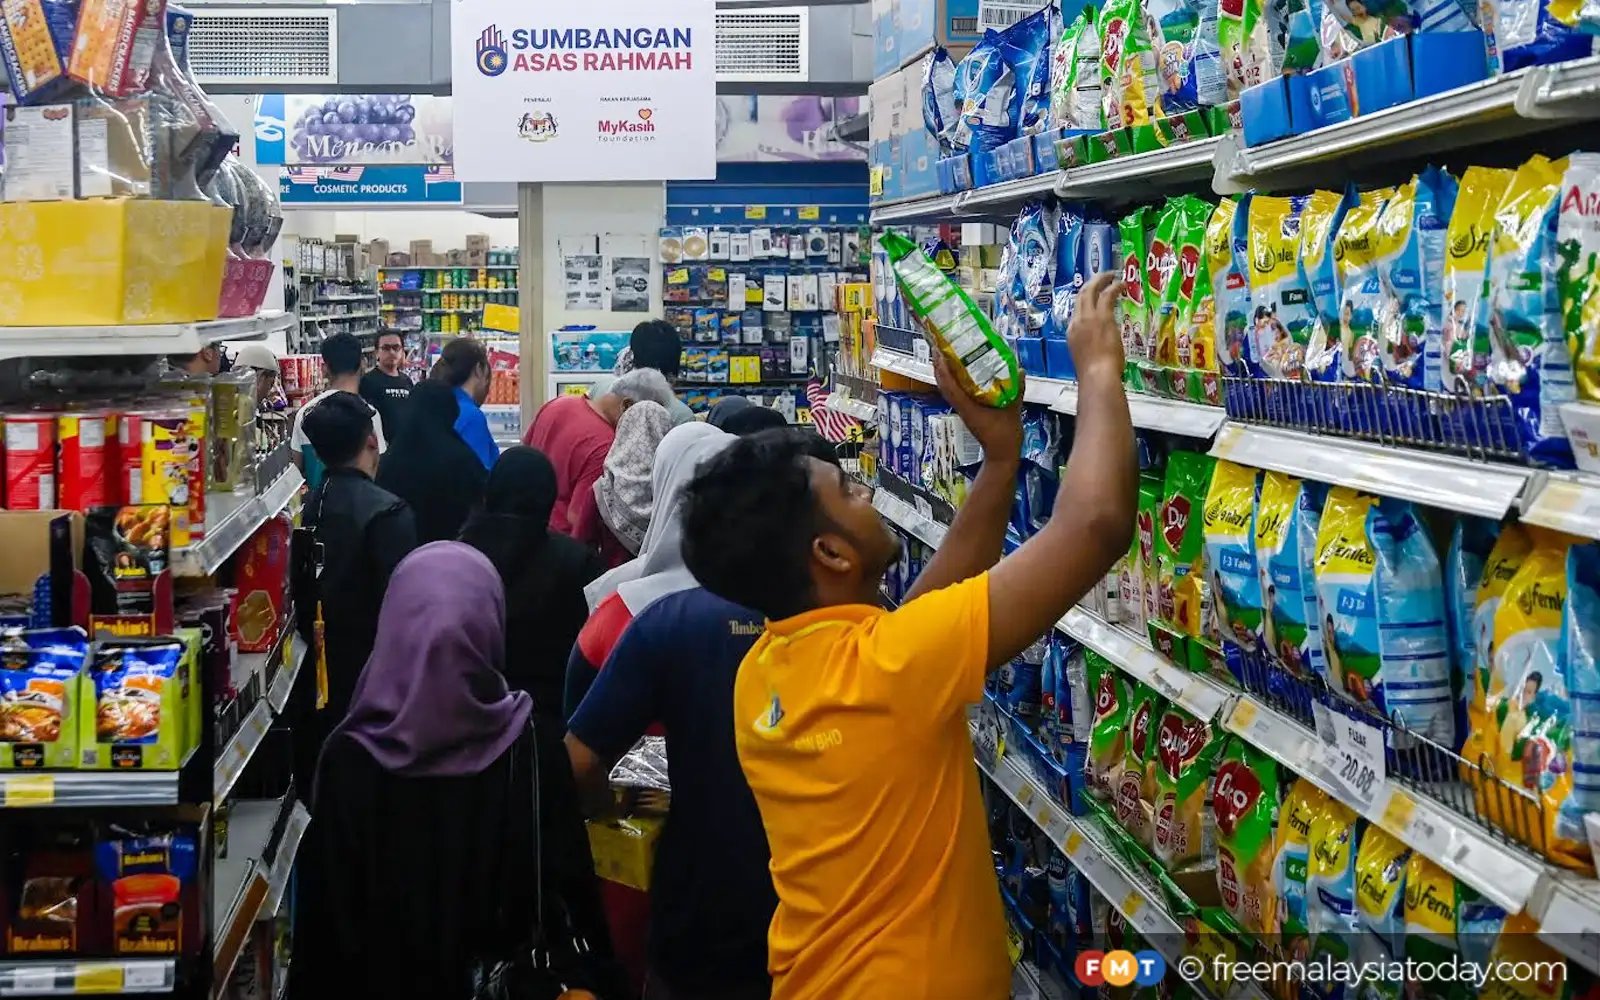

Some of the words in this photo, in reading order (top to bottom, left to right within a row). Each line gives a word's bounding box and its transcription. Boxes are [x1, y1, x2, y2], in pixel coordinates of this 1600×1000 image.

[512, 27, 692, 49] SUMBANGAN
[512, 53, 578, 72] ASAS
[583, 52, 692, 71] RAHMAH
[598, 119, 655, 135] MyKasih
[313, 184, 358, 194] COSMETIC
[360, 184, 408, 194] PRODUCTS
